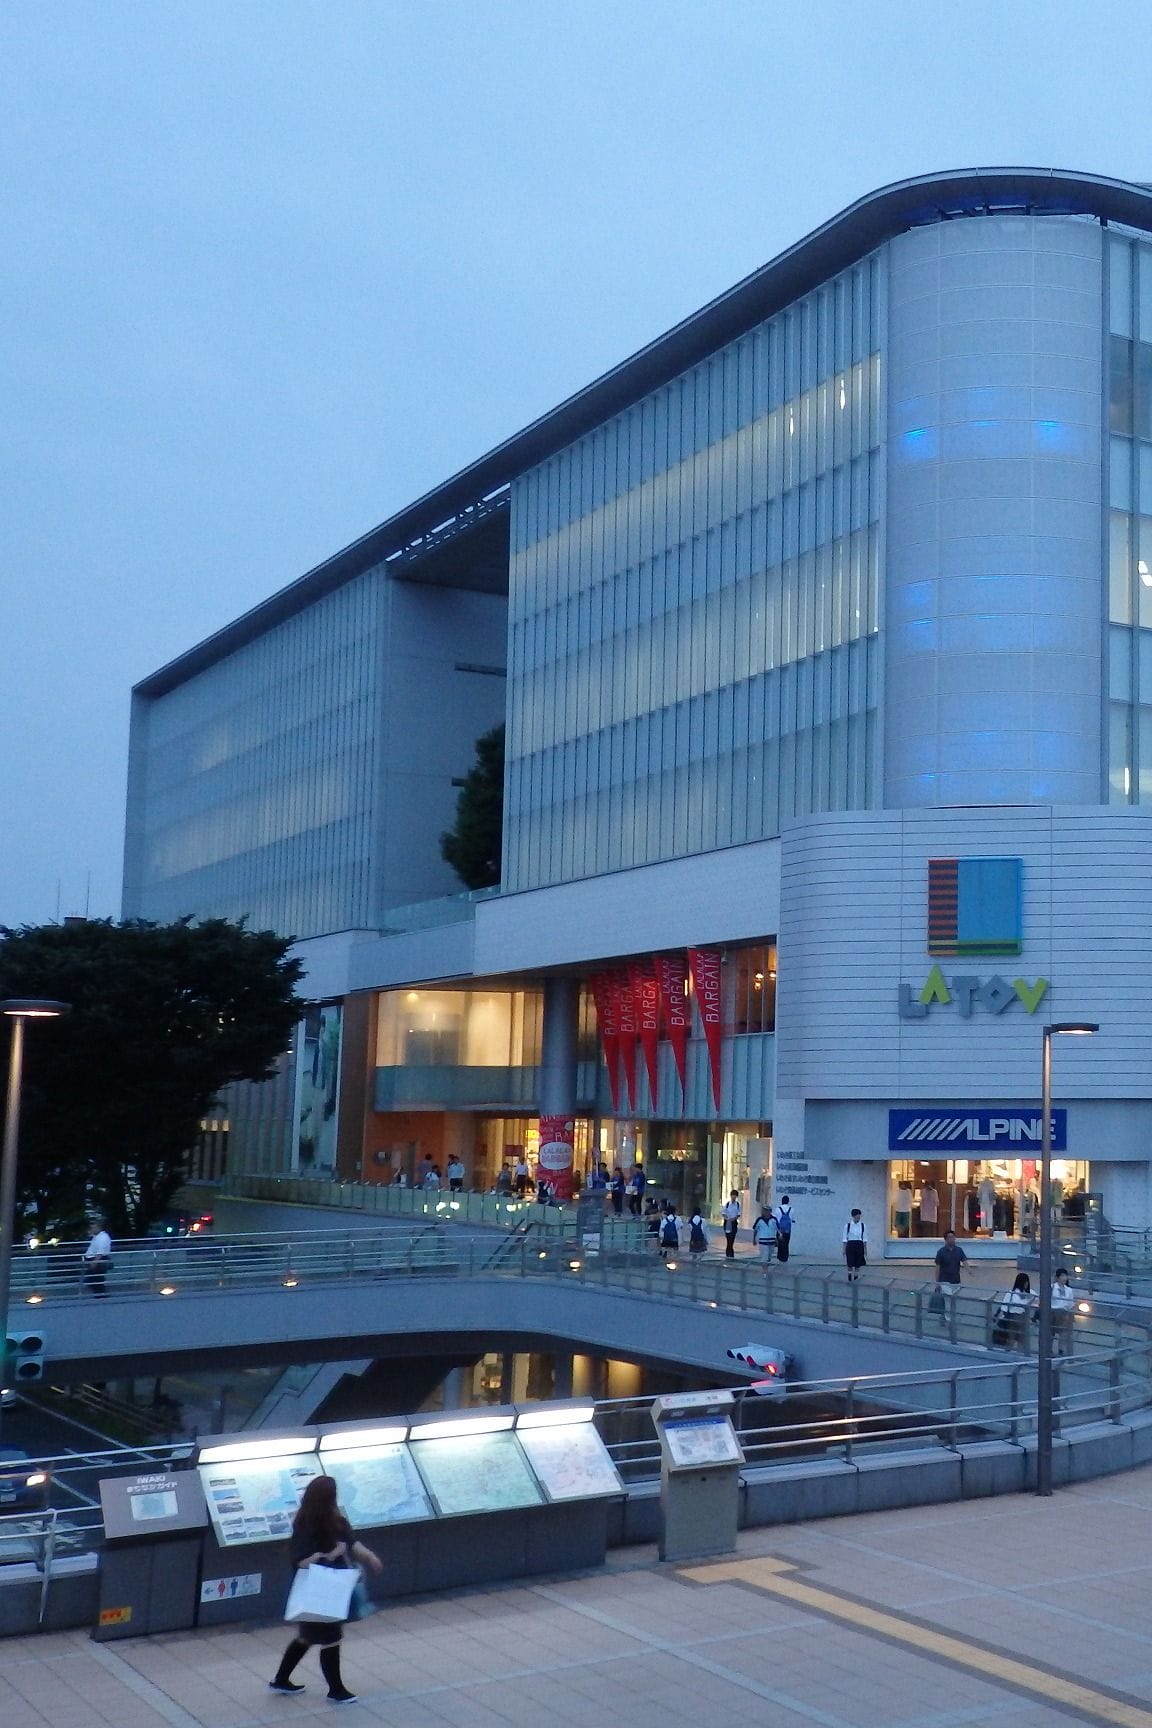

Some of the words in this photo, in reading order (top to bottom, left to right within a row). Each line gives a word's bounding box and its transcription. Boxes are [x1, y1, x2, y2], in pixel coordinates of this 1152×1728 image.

[705, 953, 719, 1023] BARGAIN
[898, 963, 1049, 1019] LATOV
[946, 1118, 1057, 1141] ALPINE
